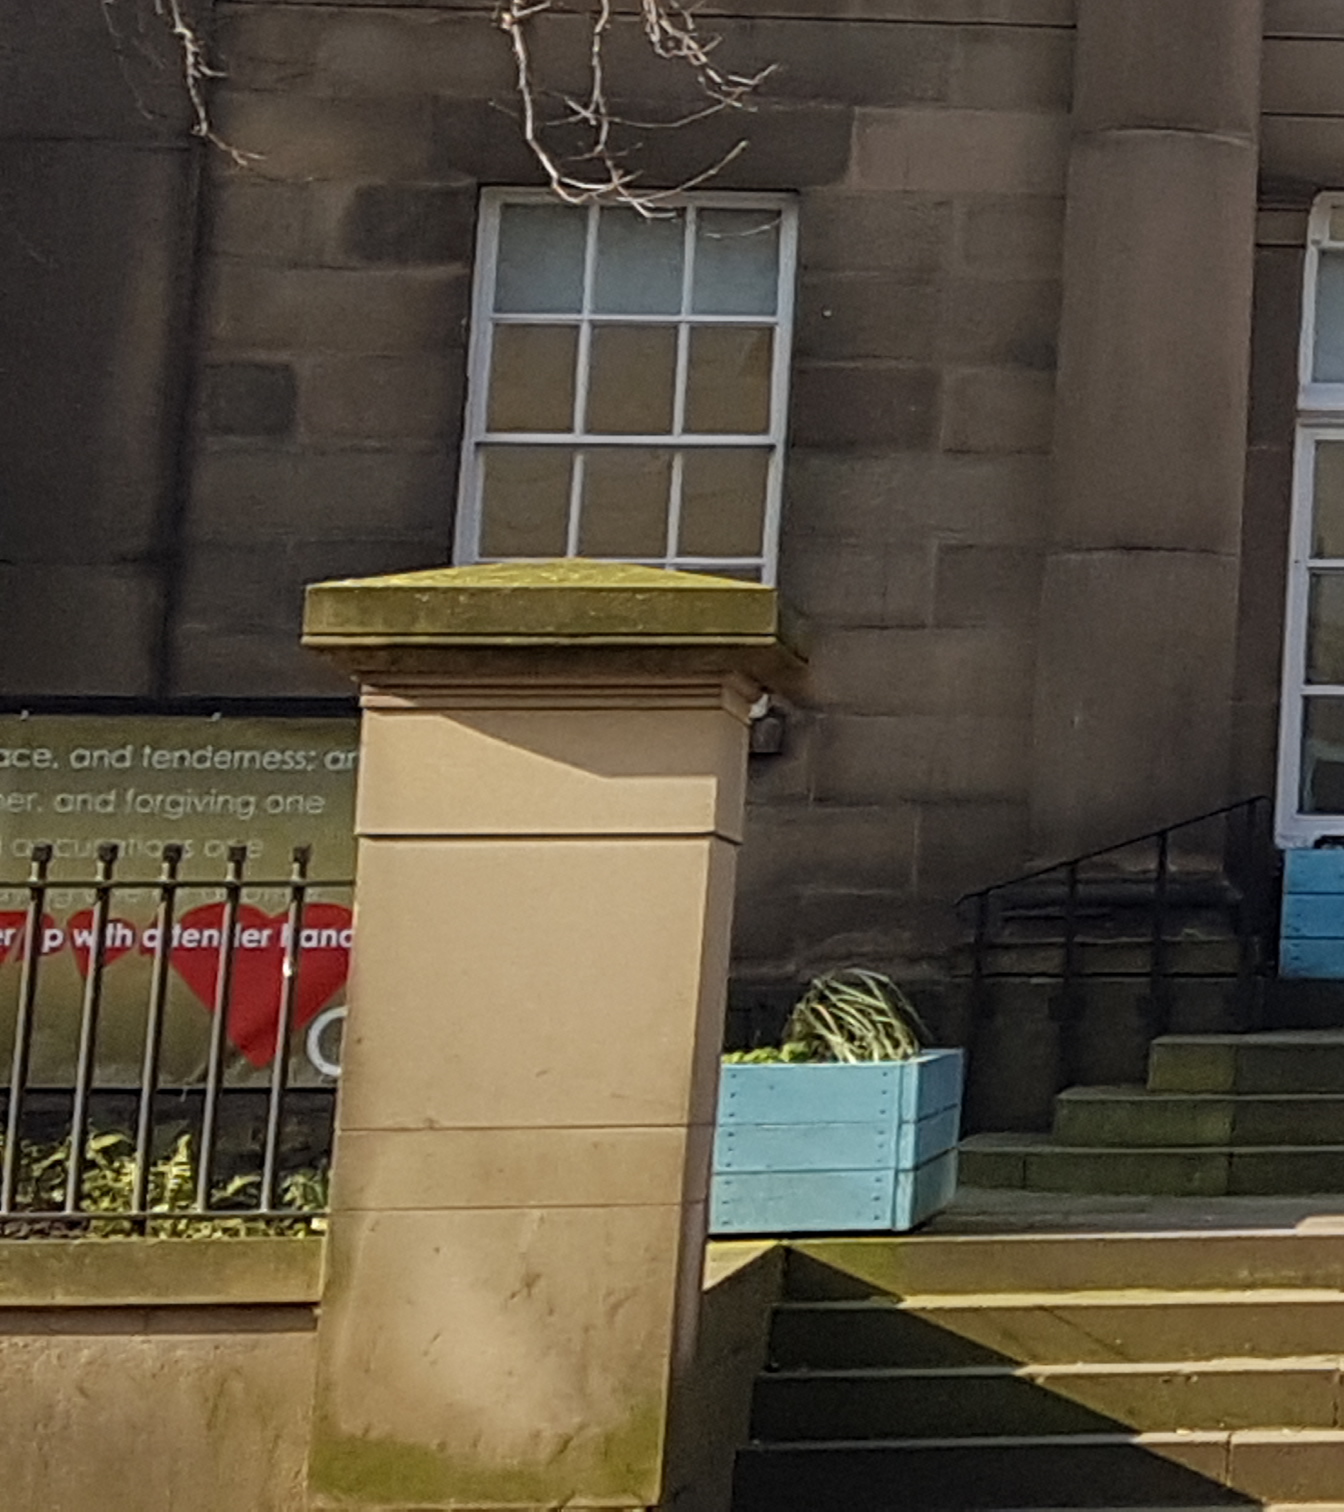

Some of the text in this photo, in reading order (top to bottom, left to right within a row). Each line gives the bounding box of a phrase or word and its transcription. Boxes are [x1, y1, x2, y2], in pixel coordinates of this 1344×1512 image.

[70, 745, 133, 769] and
[54, 789, 117, 813] and
[126, 788, 256, 820] forgiving
[265, 793, 325, 814] one
[73, 923, 133, 948] wth
